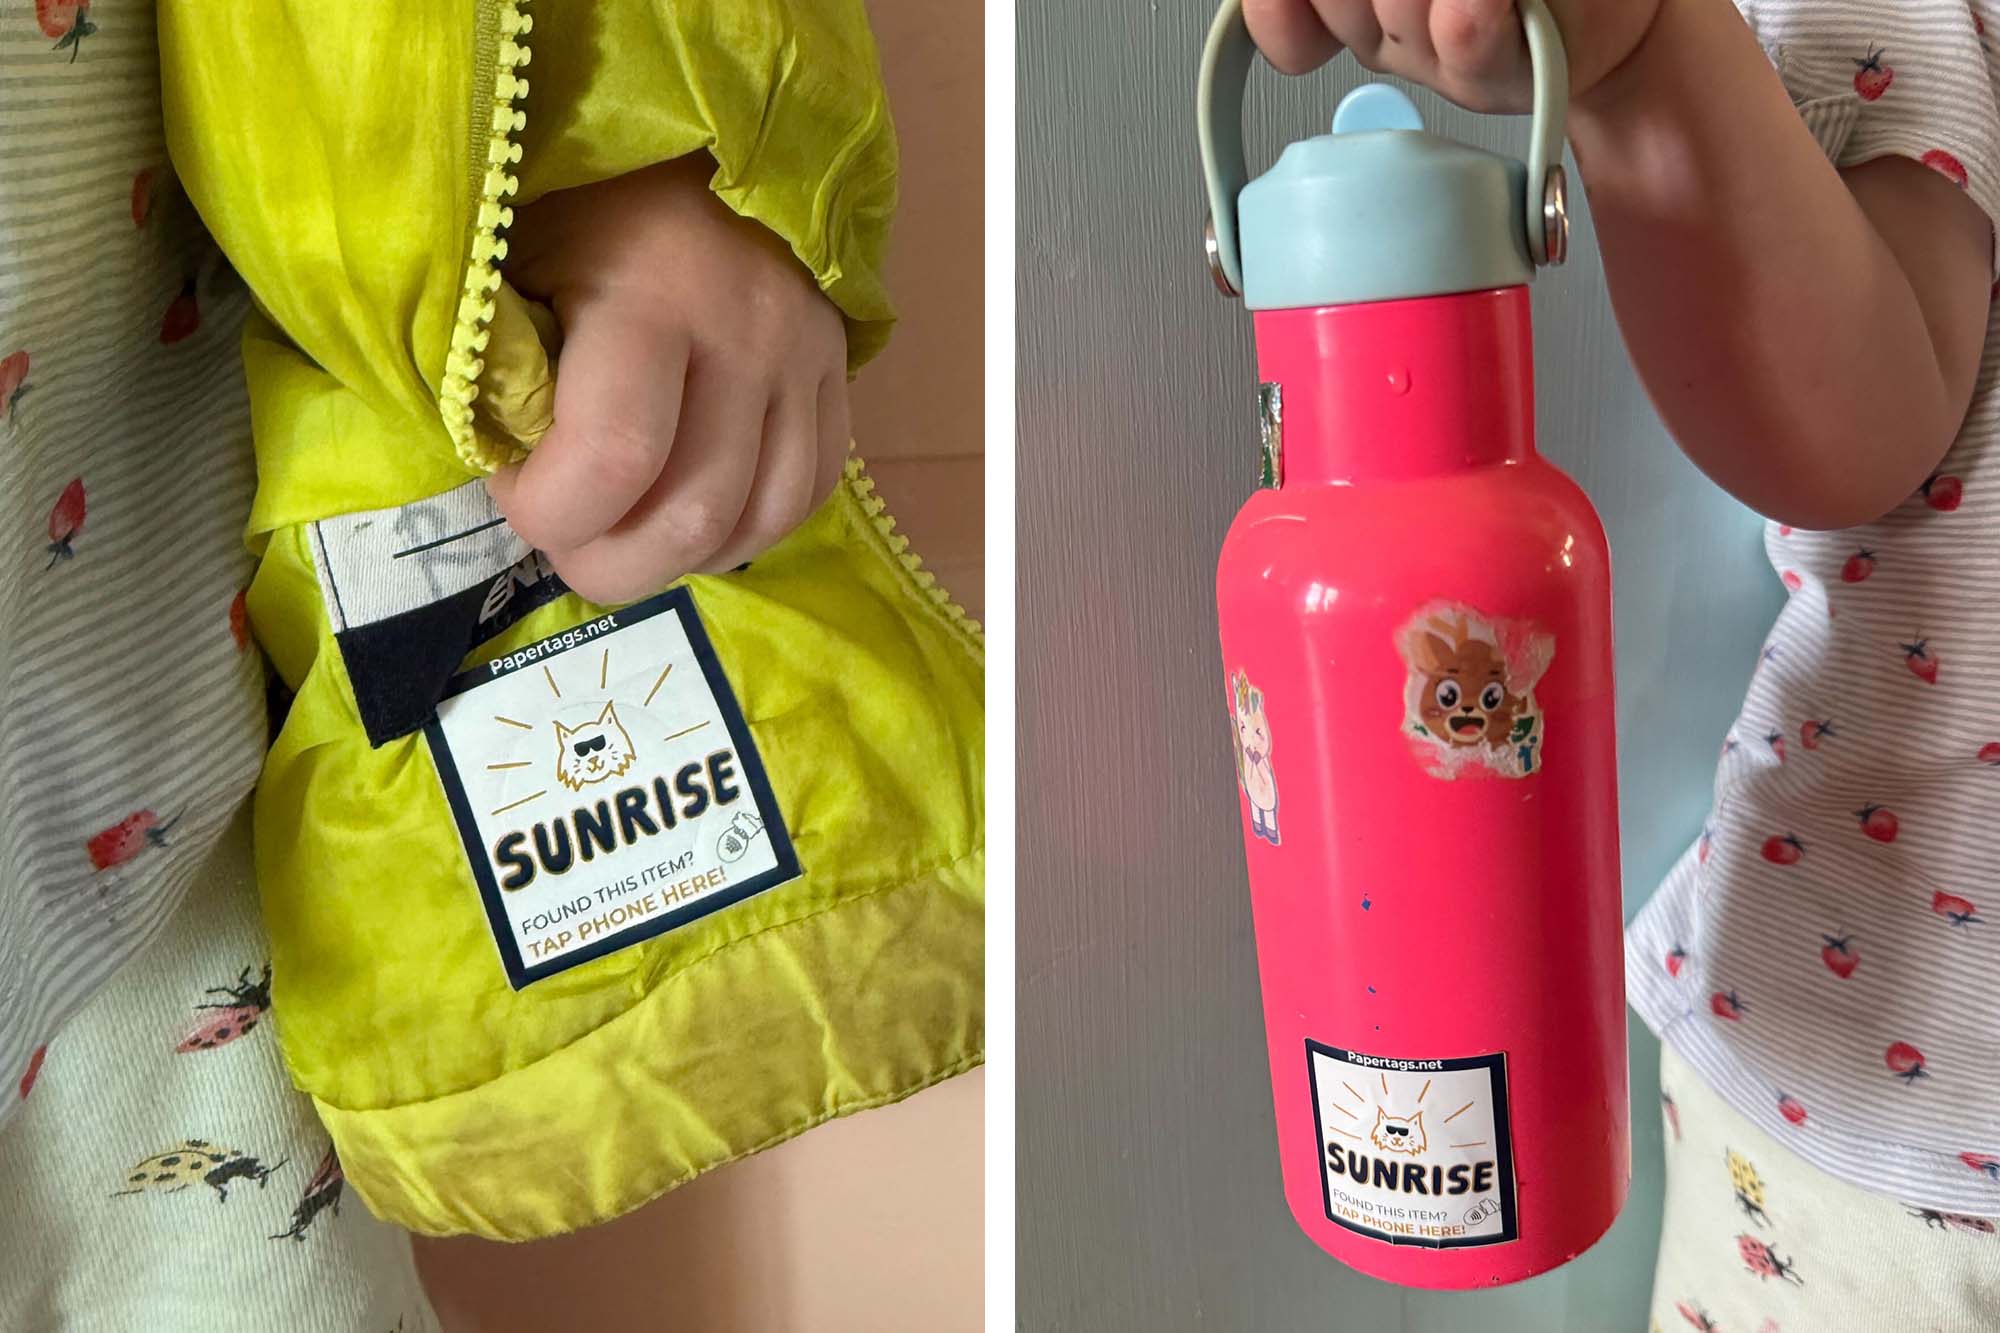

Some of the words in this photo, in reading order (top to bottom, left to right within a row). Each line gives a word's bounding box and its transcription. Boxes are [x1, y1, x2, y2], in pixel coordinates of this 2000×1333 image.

[490, 614, 618, 675] Papertags.net
[496, 749, 741, 892] SUNRISE
[522, 893, 592, 935] FOUND
[598, 877, 639, 905] THIS
[641, 851, 694, 885] ITEM?
[528, 930, 572, 959] TAP
[579, 894, 659, 941] PHONE
[662, 866, 728, 905] HERE!
[1347, 1051, 1443, 1070] Papertags.net
[1327, 1142, 1495, 1196] SUNRISE
[1333, 1188, 1374, 1212] FOUND
[1376, 1205, 1405, 1218] THIS
[1408, 1209, 1448, 1221] ITEM?
[1335, 1203, 1359, 1220] TAP
[1363, 1215, 1415, 1235] PHONE
[1419, 1225, 1466, 1237] HERE!
